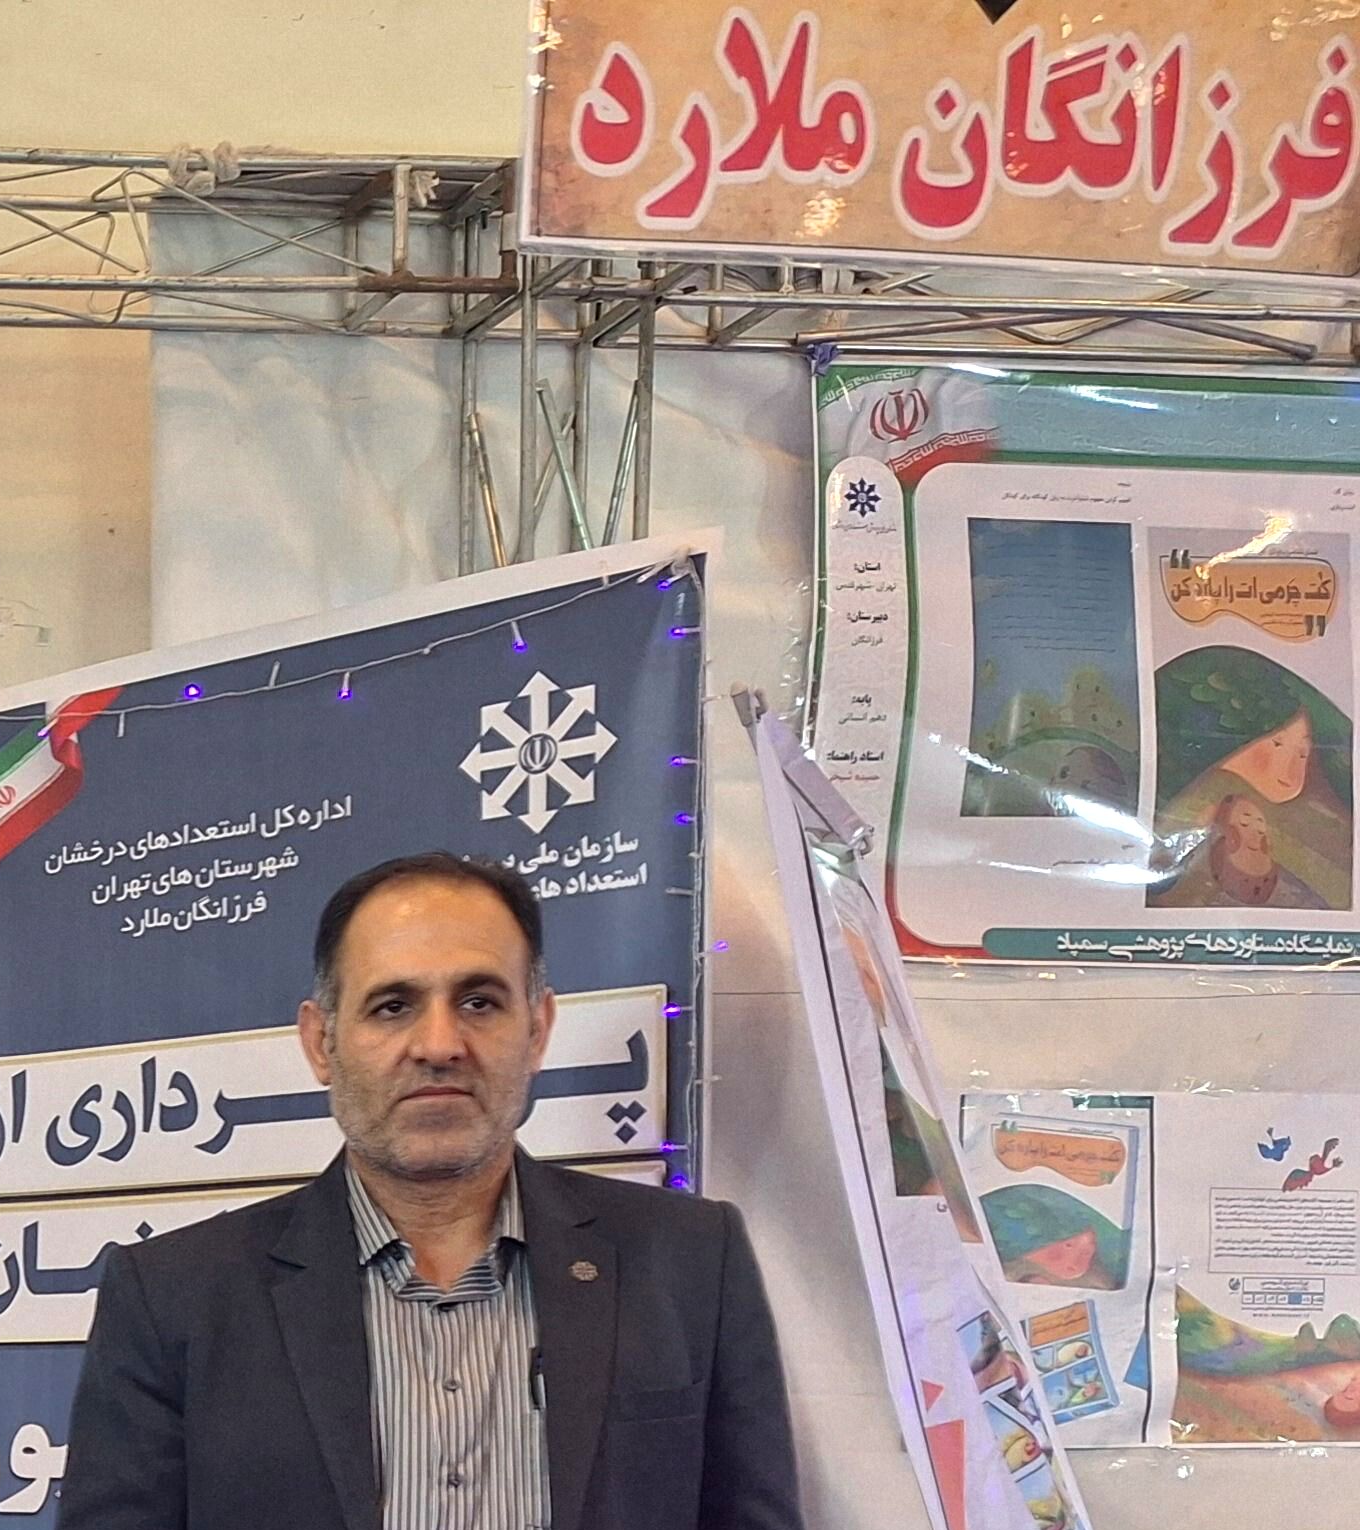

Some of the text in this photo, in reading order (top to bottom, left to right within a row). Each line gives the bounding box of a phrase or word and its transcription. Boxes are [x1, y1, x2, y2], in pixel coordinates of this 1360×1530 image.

[581, 17, 1359, 248] فرزانگان ملارد
[45, 795, 353, 874] اداره کل استعدادهای درخشان
[562, 831, 639, 868] سازمان
[91, 847, 300, 905] شهرستان های تهران
[517, 842, 559, 875] ملی
[566, 863, 648, 894] استعداد
[121, 891, 267, 937] فرزانگان ملارد
[1056, 932, 1108, 957] سمپاد
[1108, 933, 1185, 962] پژوهشی
